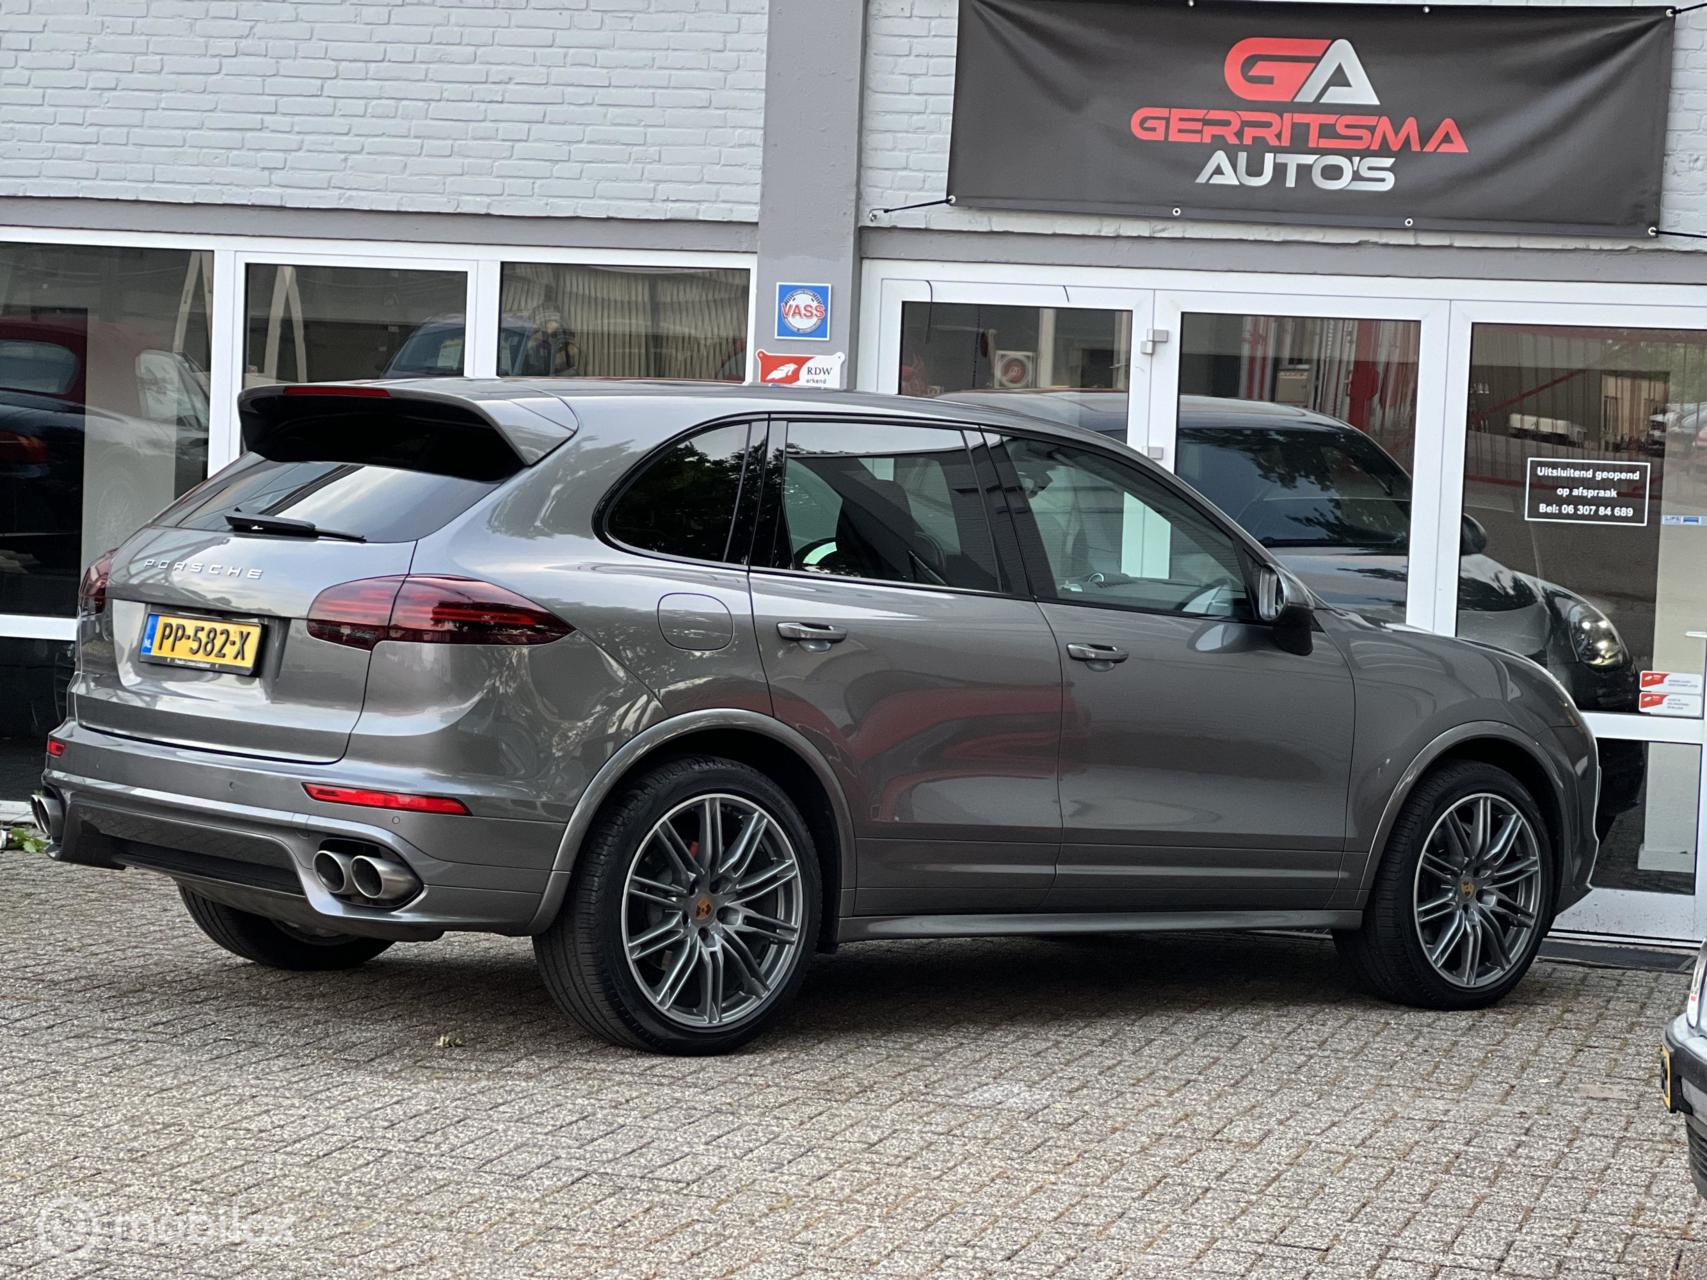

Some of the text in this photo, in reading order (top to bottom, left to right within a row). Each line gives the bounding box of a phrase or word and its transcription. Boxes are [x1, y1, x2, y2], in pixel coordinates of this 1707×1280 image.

[1224, 37, 1380, 105] GA
[1130, 106, 1469, 153] GERRITSMA
[1195, 150, 1396, 191] AUTO'S
[781, 303, 826, 320] VASS
[807, 366, 832, 376] RDW
[1537, 467, 1640, 481] Uitsluitend geopend
[1556, 486, 1618, 499] op afspraak
[1539, 503, 1634, 517] Bel: 06 307 84 689
[144, 559, 263, 580] PORSCHE
[158, 622, 252, 661] PP-582-X
